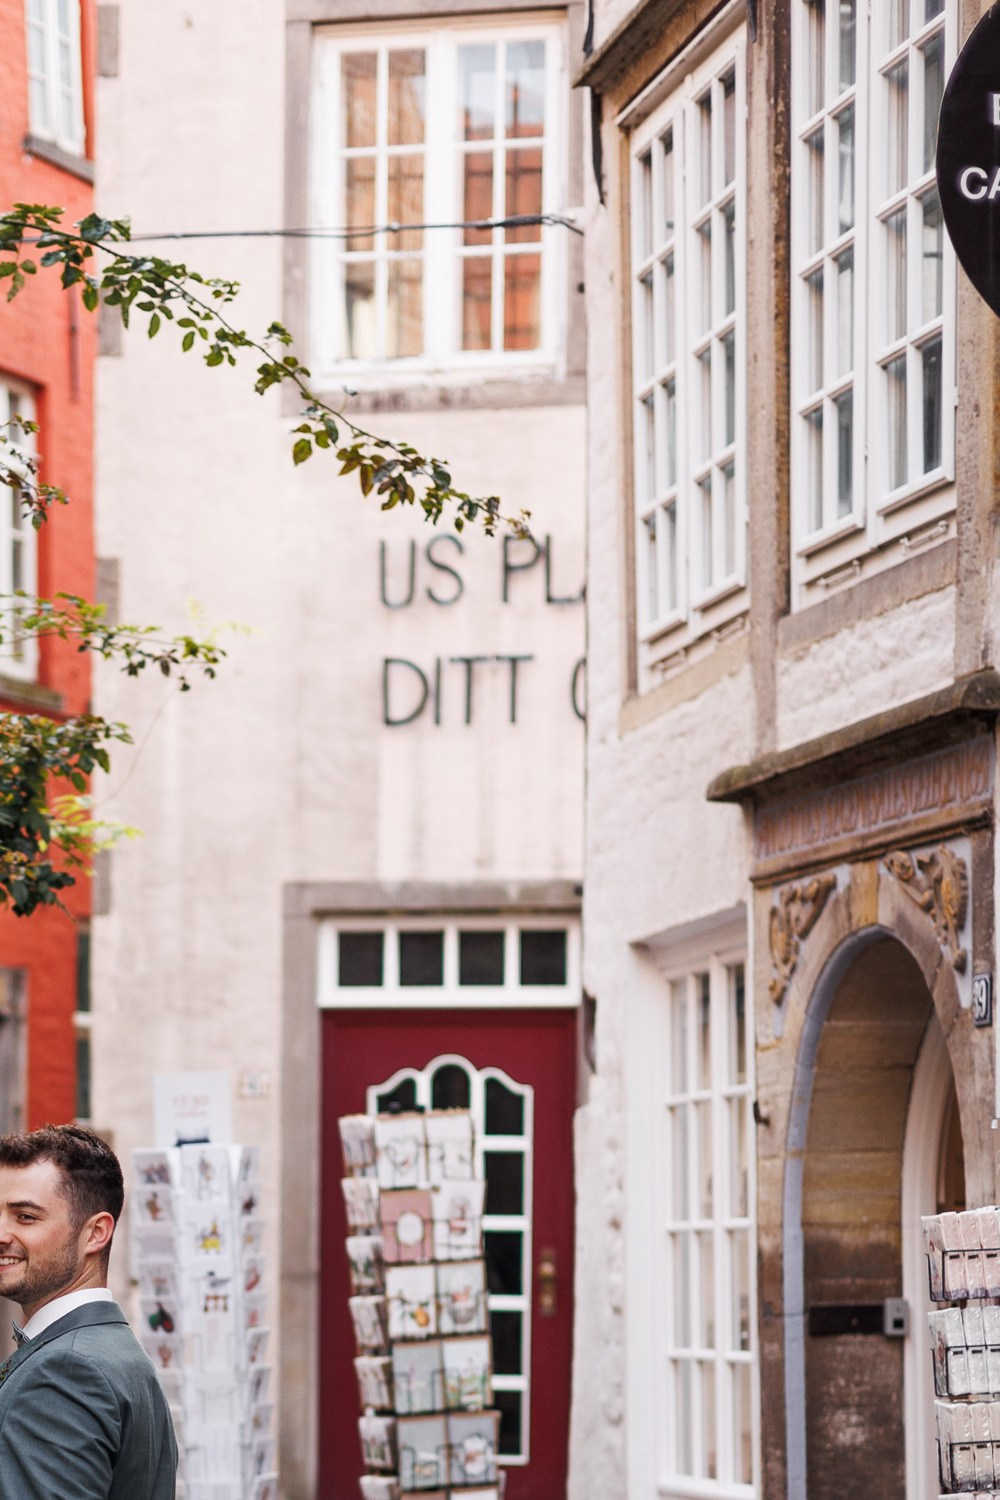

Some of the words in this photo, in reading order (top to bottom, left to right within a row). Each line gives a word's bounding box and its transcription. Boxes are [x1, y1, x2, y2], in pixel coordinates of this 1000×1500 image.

[379, 533, 464, 609] US
[501, 533, 586, 604] PL
[383, 654, 534, 727] DITT
